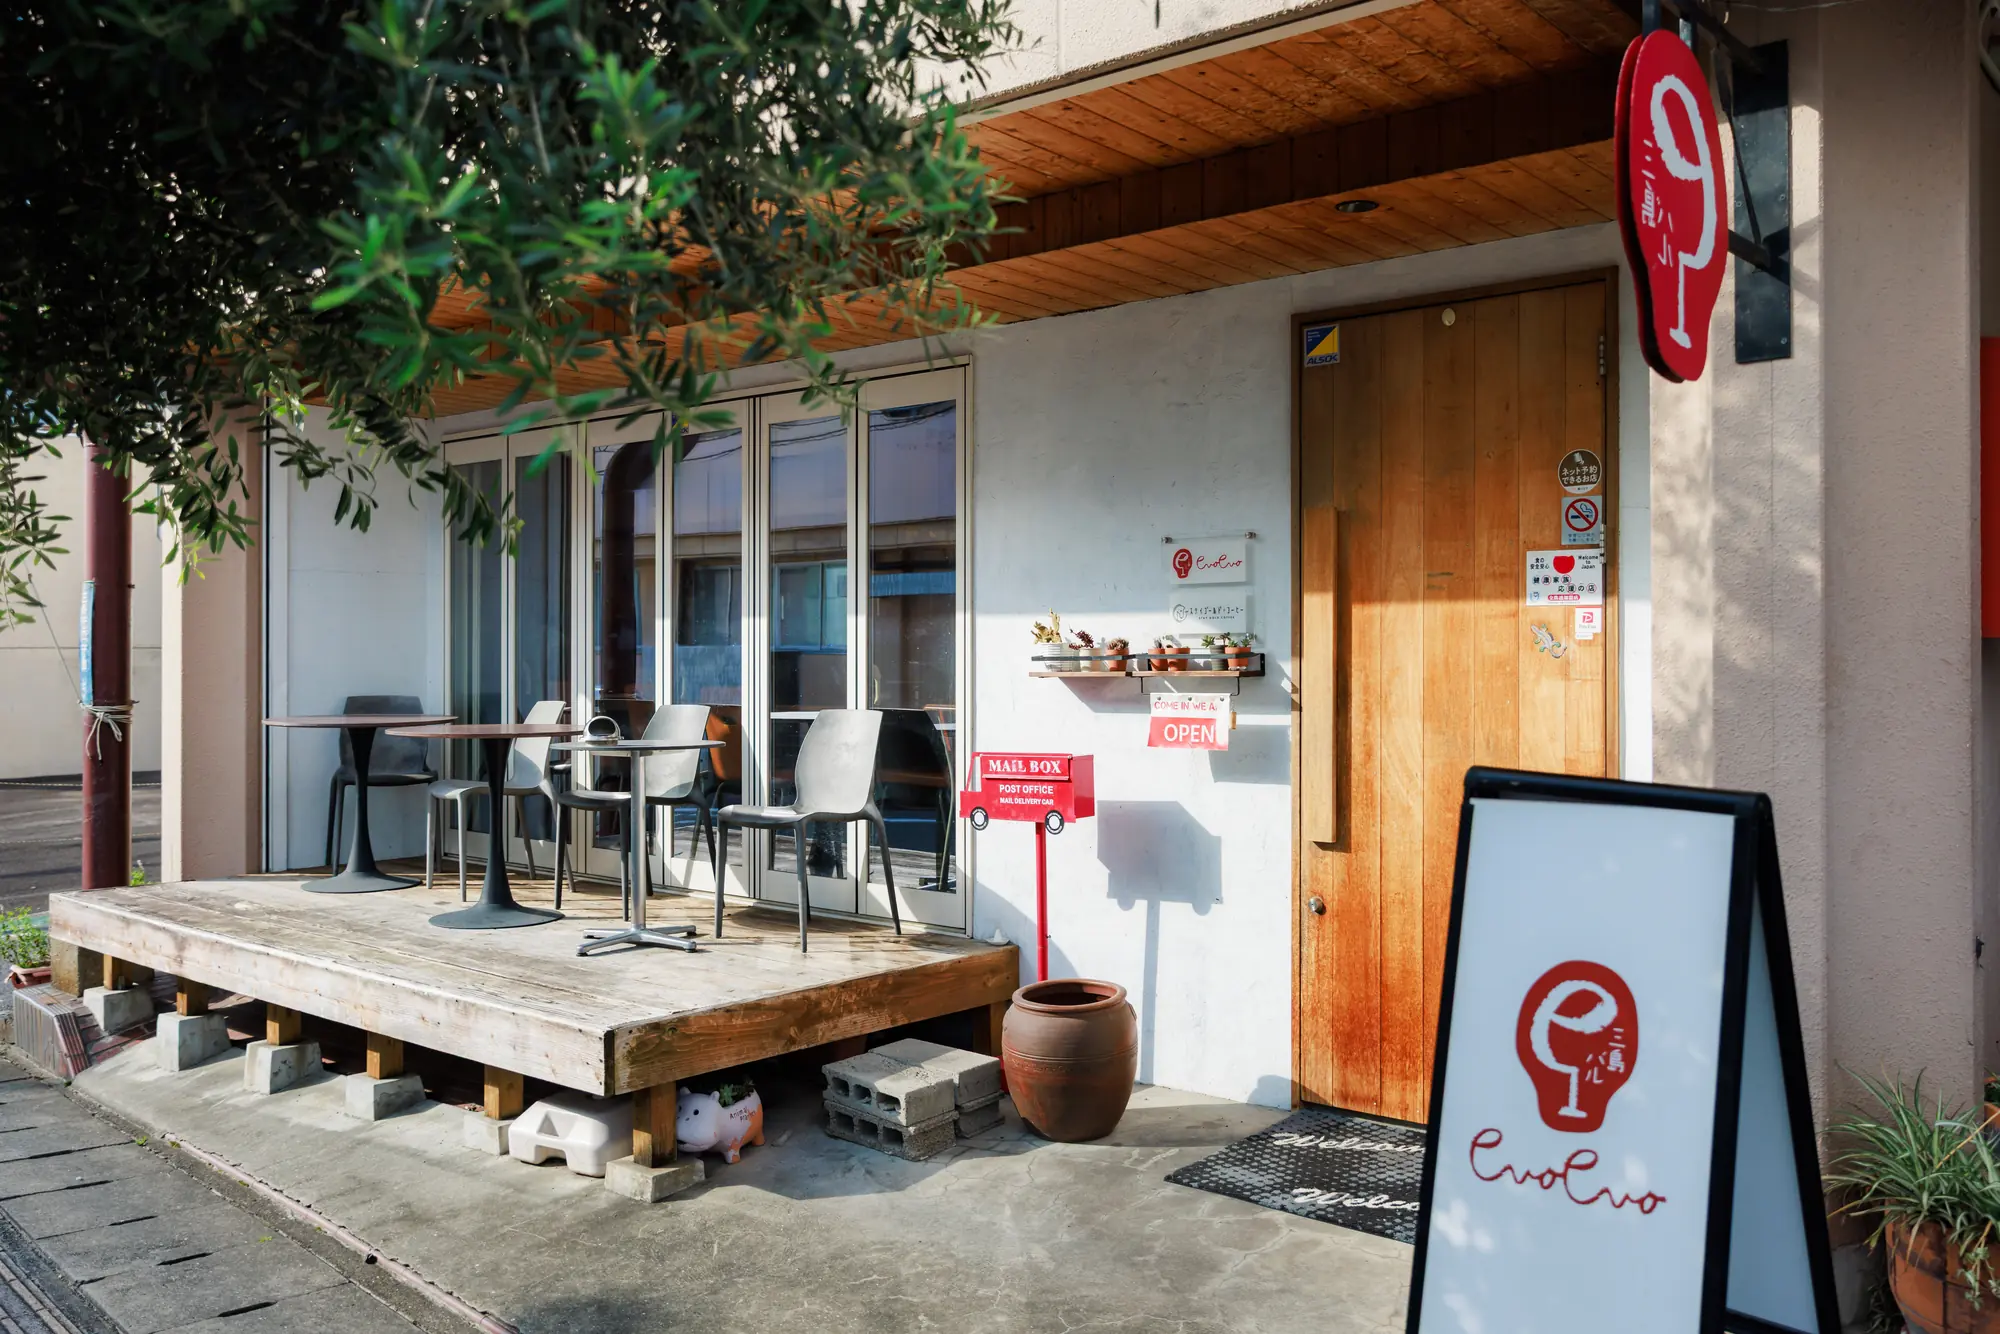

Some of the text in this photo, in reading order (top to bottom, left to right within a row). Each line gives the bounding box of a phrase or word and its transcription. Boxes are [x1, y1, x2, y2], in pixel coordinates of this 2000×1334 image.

[1306, 354, 1338, 365] ALSOK
[1562, 465, 1598, 476] ネット予約
[1562, 474, 1598, 485] できるお店
[1154, 701, 1217, 711] COME IN WE A
[1164, 723, 1215, 743] OPEN
[988, 759, 1062, 774] MAIL BOX
[999, 784, 1054, 795] POST OFFICE
[1014, 797, 1041, 805] DELIVERY
[1041, 798, 1054, 806] CAR
[730, 1106, 748, 1120] Animal
[1270, 1132, 1426, 1153] Welcom
[1291, 1187, 1420, 1211] Welco
